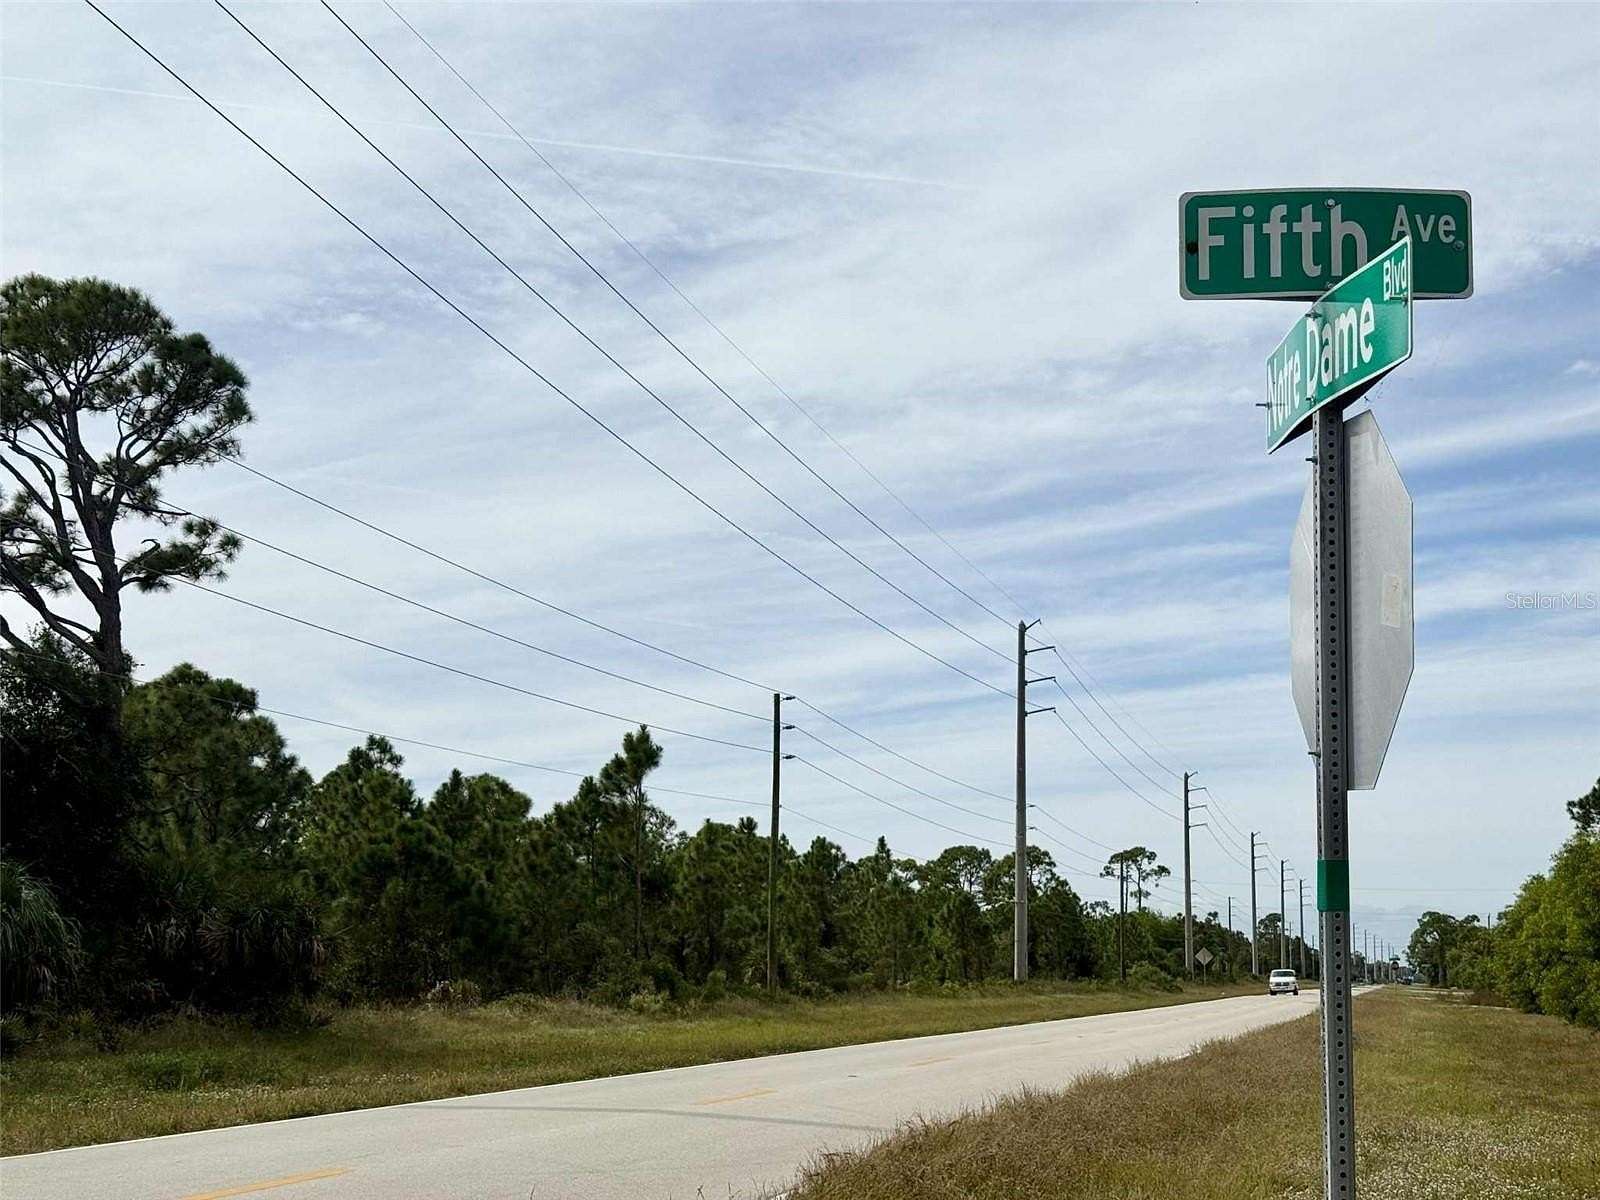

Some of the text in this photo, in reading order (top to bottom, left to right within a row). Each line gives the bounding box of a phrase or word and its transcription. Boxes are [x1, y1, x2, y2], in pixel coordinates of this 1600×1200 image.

[1198, 204, 1457, 280] Fifth Ave
[1268, 248, 1408, 434] Notre Dame Blvd
